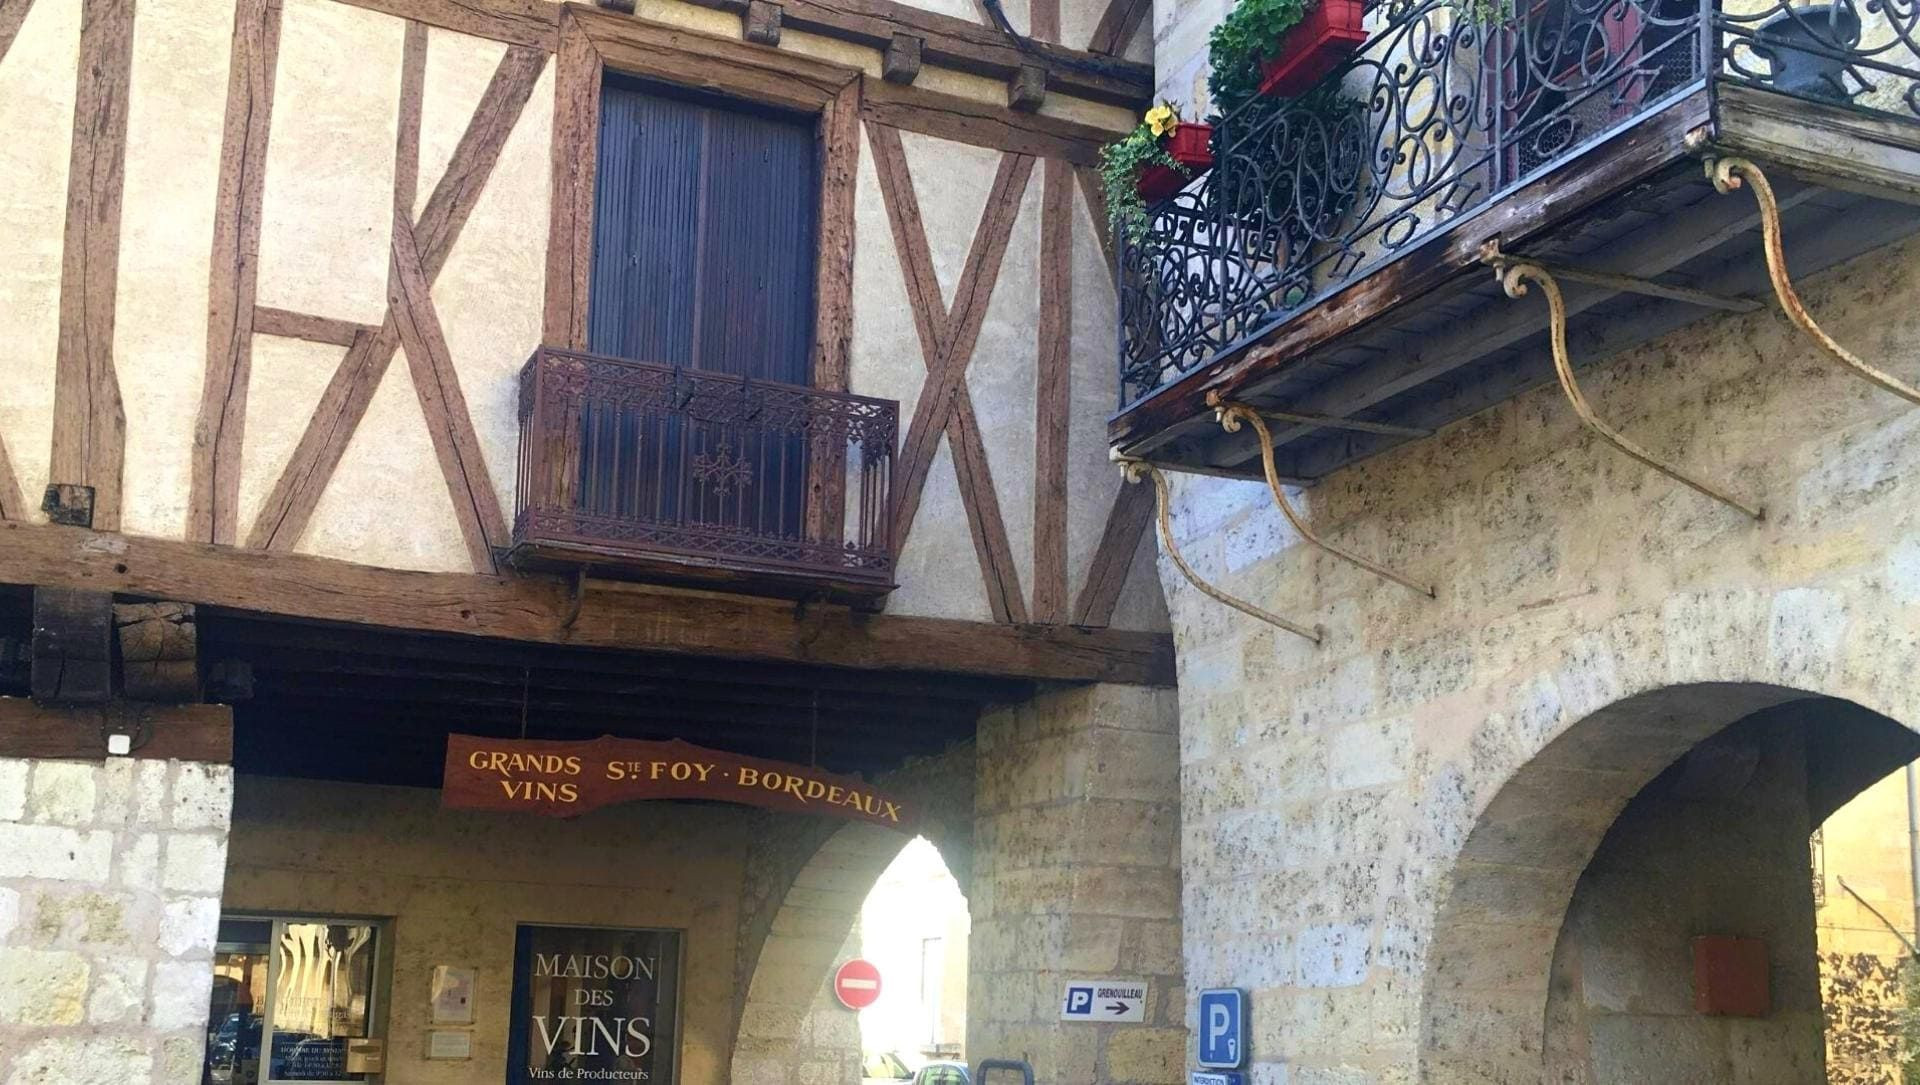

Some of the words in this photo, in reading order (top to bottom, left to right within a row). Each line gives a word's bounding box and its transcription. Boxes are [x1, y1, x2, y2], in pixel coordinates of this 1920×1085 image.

[469, 750, 582, 778] GRANDS
[501, 780, 579, 803] VINS
[650, 761, 716, 781] FOY
[738, 767, 901, 822] BORDEAUX
[534, 953, 655, 980] MAISON
[574, 989, 614, 1007] DES
[532, 1016, 651, 1058] VINS
[528, 1067, 555, 1079] Vins
[557, 1067, 574, 1079] de
[577, 1068, 649, 1081] Producteurs
